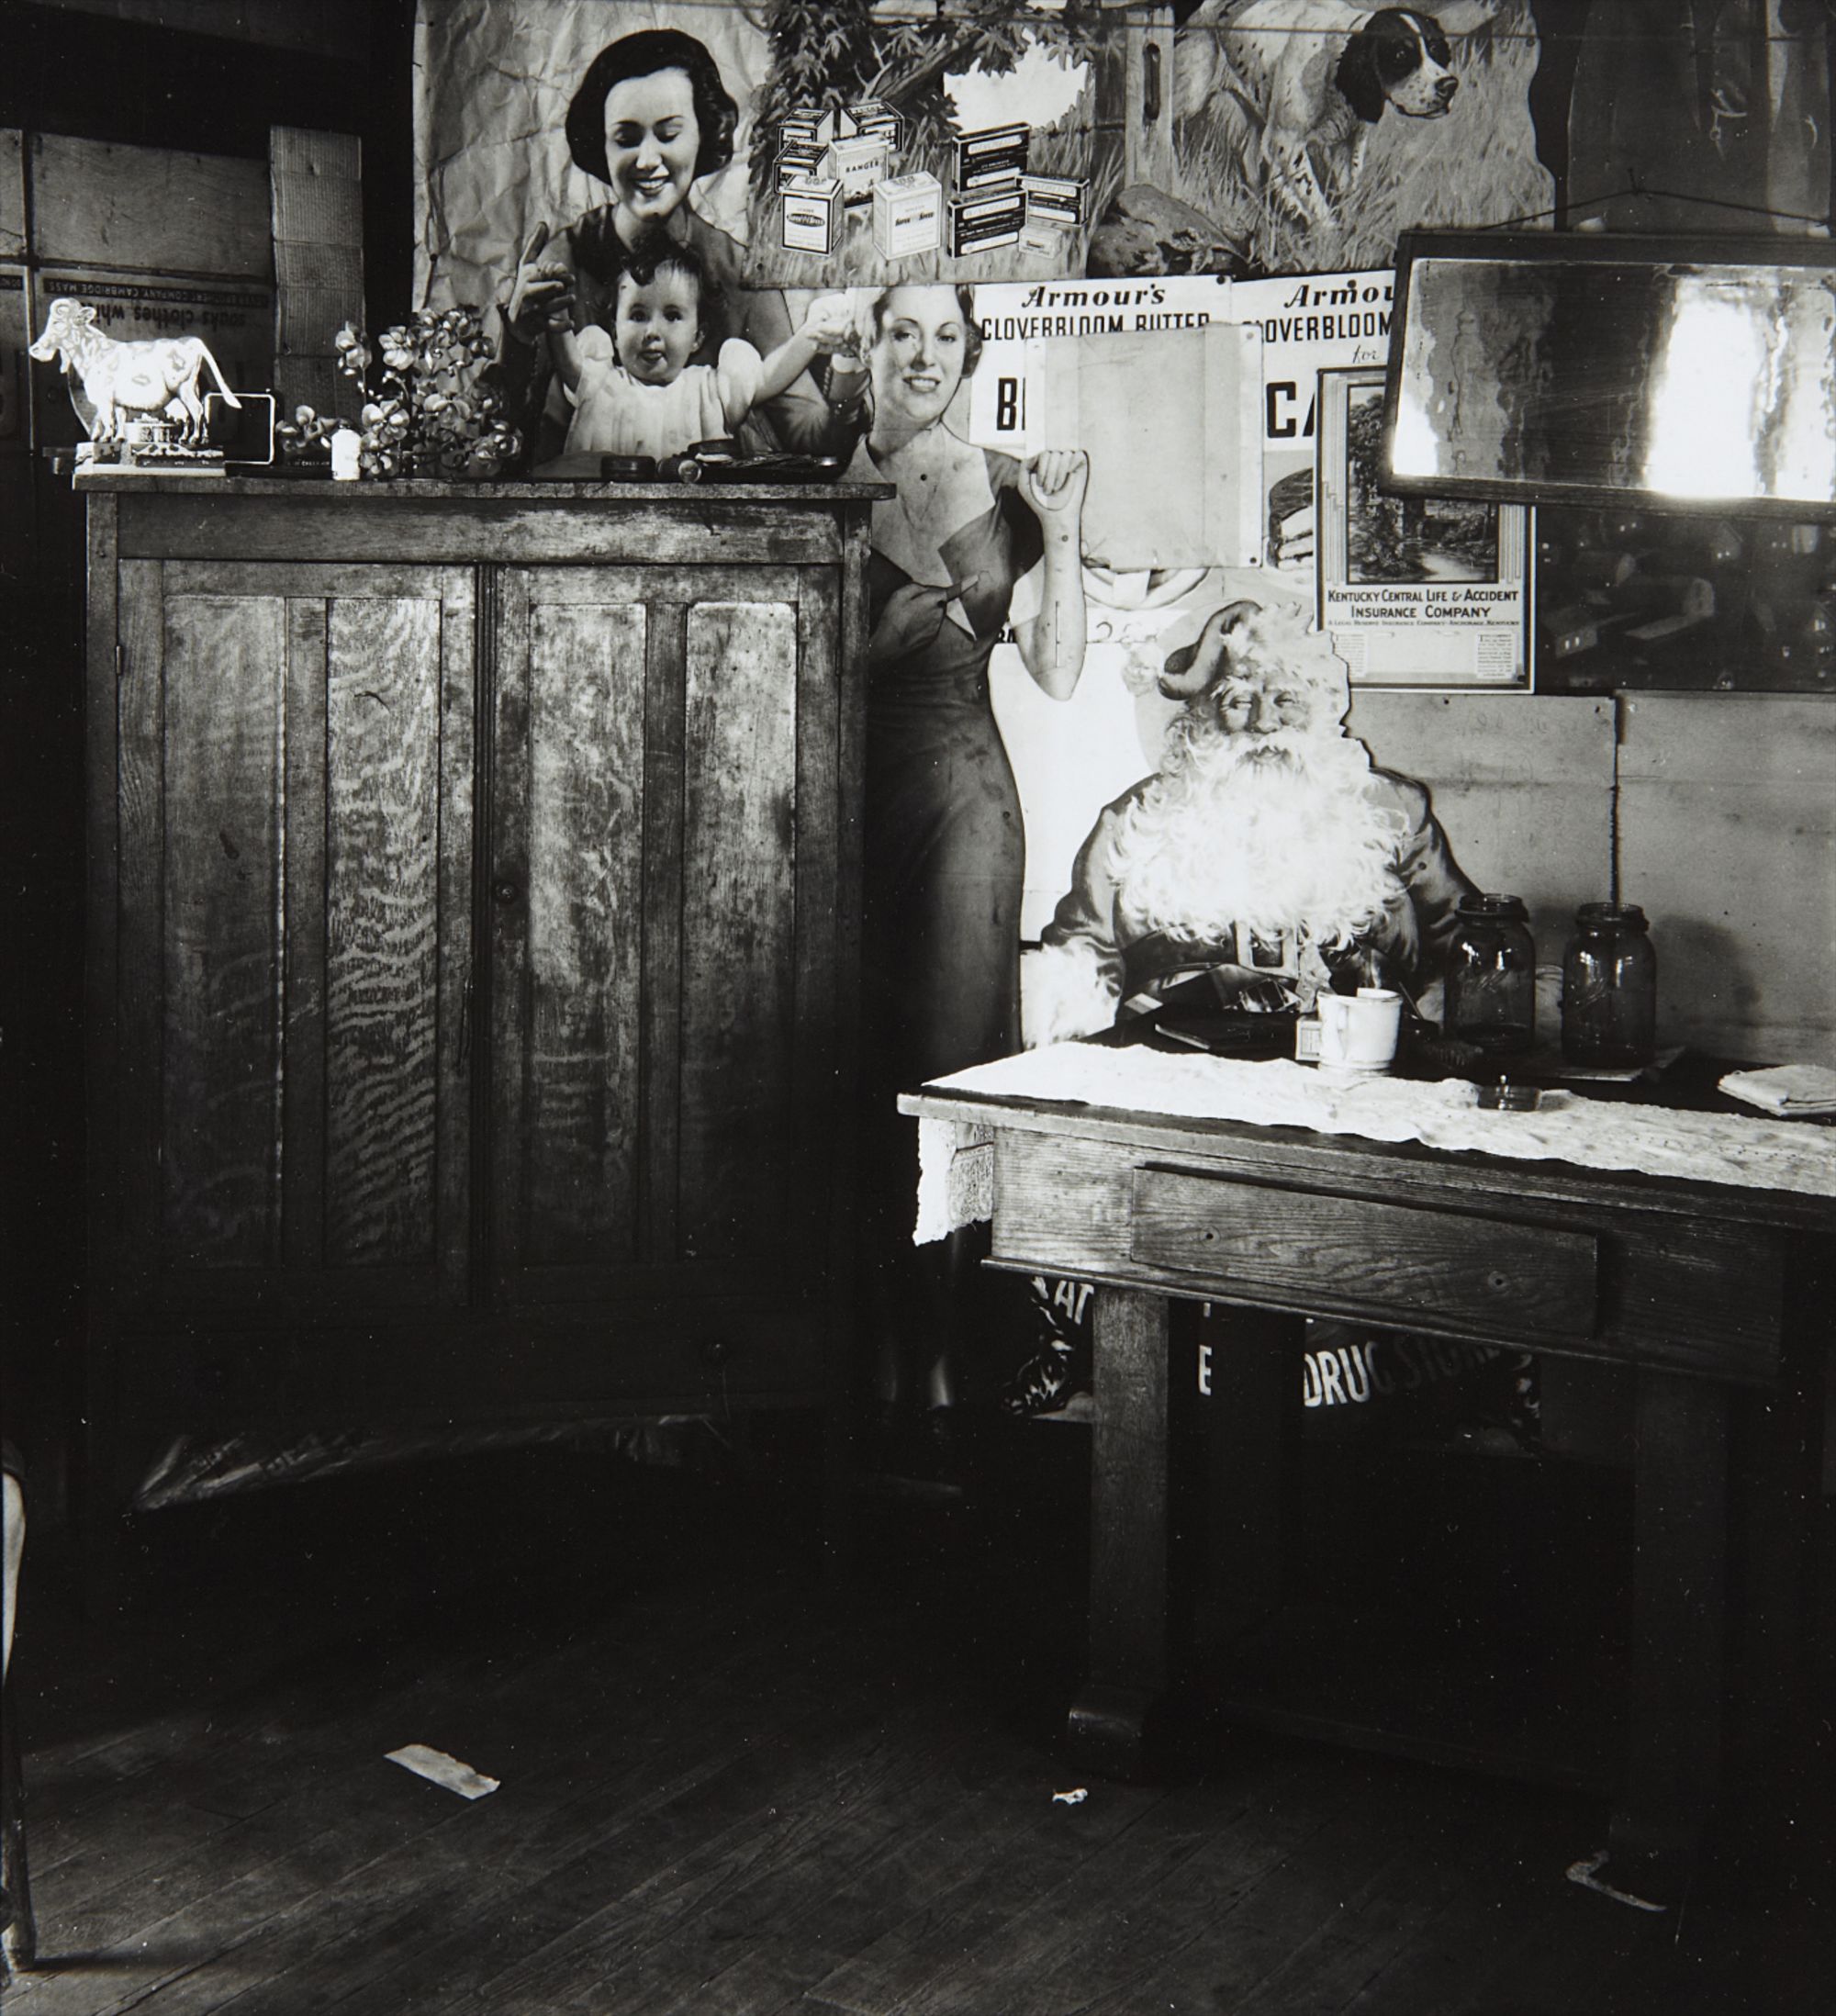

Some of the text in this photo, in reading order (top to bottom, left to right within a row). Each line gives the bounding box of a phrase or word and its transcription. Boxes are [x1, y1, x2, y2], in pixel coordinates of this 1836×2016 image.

[845, 161, 879, 173] RANGER
[1021, 283, 1166, 308] Armour's
[133, 306, 195, 331] clothes
[1242, 311, 1393, 343] OVERBLOOM
[1352, 344, 1379, 364] for
[1327, 588, 1519, 602] KENTUCKY CENTRAL LIFE & ACCIDENT
[1350, 605, 1492, 618] INSURANCE COMPANY
[1304, 1340, 1395, 1408] DRUG
